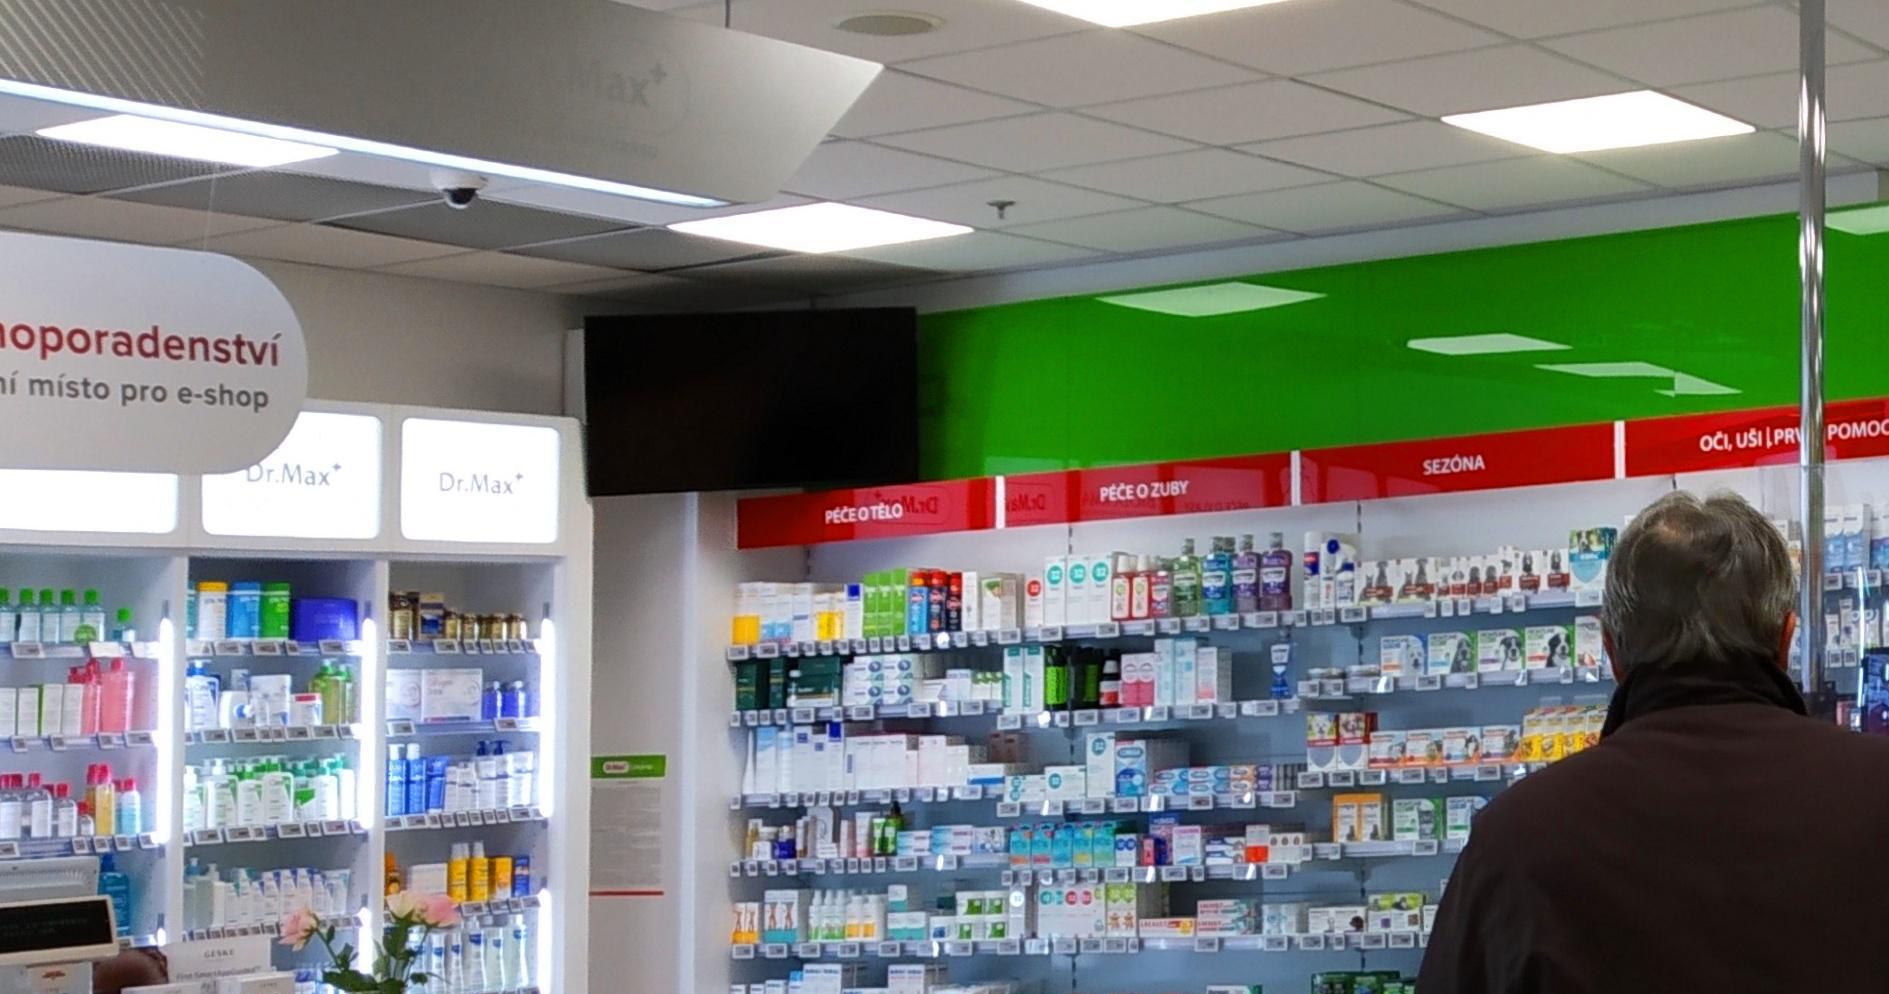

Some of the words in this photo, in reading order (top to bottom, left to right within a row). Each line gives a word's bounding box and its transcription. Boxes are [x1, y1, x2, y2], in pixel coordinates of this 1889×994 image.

[28, 372, 111, 400] místo
[121, 382, 167, 407] pro
[177, 383, 269, 413] e-shop
[1700, 431, 1732, 451] OČI,
[1736, 427, 1763, 448] UŠI
[1774, 427, 1802, 445] PRV
[1422, 453, 1486, 476] SEZÓNA
[438, 471, 514, 495] Dr.Max
[1099, 483, 1134, 502] PÉČE
[1136, 483, 1148, 499] O
[1151, 479, 1190, 498] ZUBY
[825, 504, 858, 525] PÉČE
[858, 506, 869, 521] O
[871, 502, 904, 521] TĚLO
